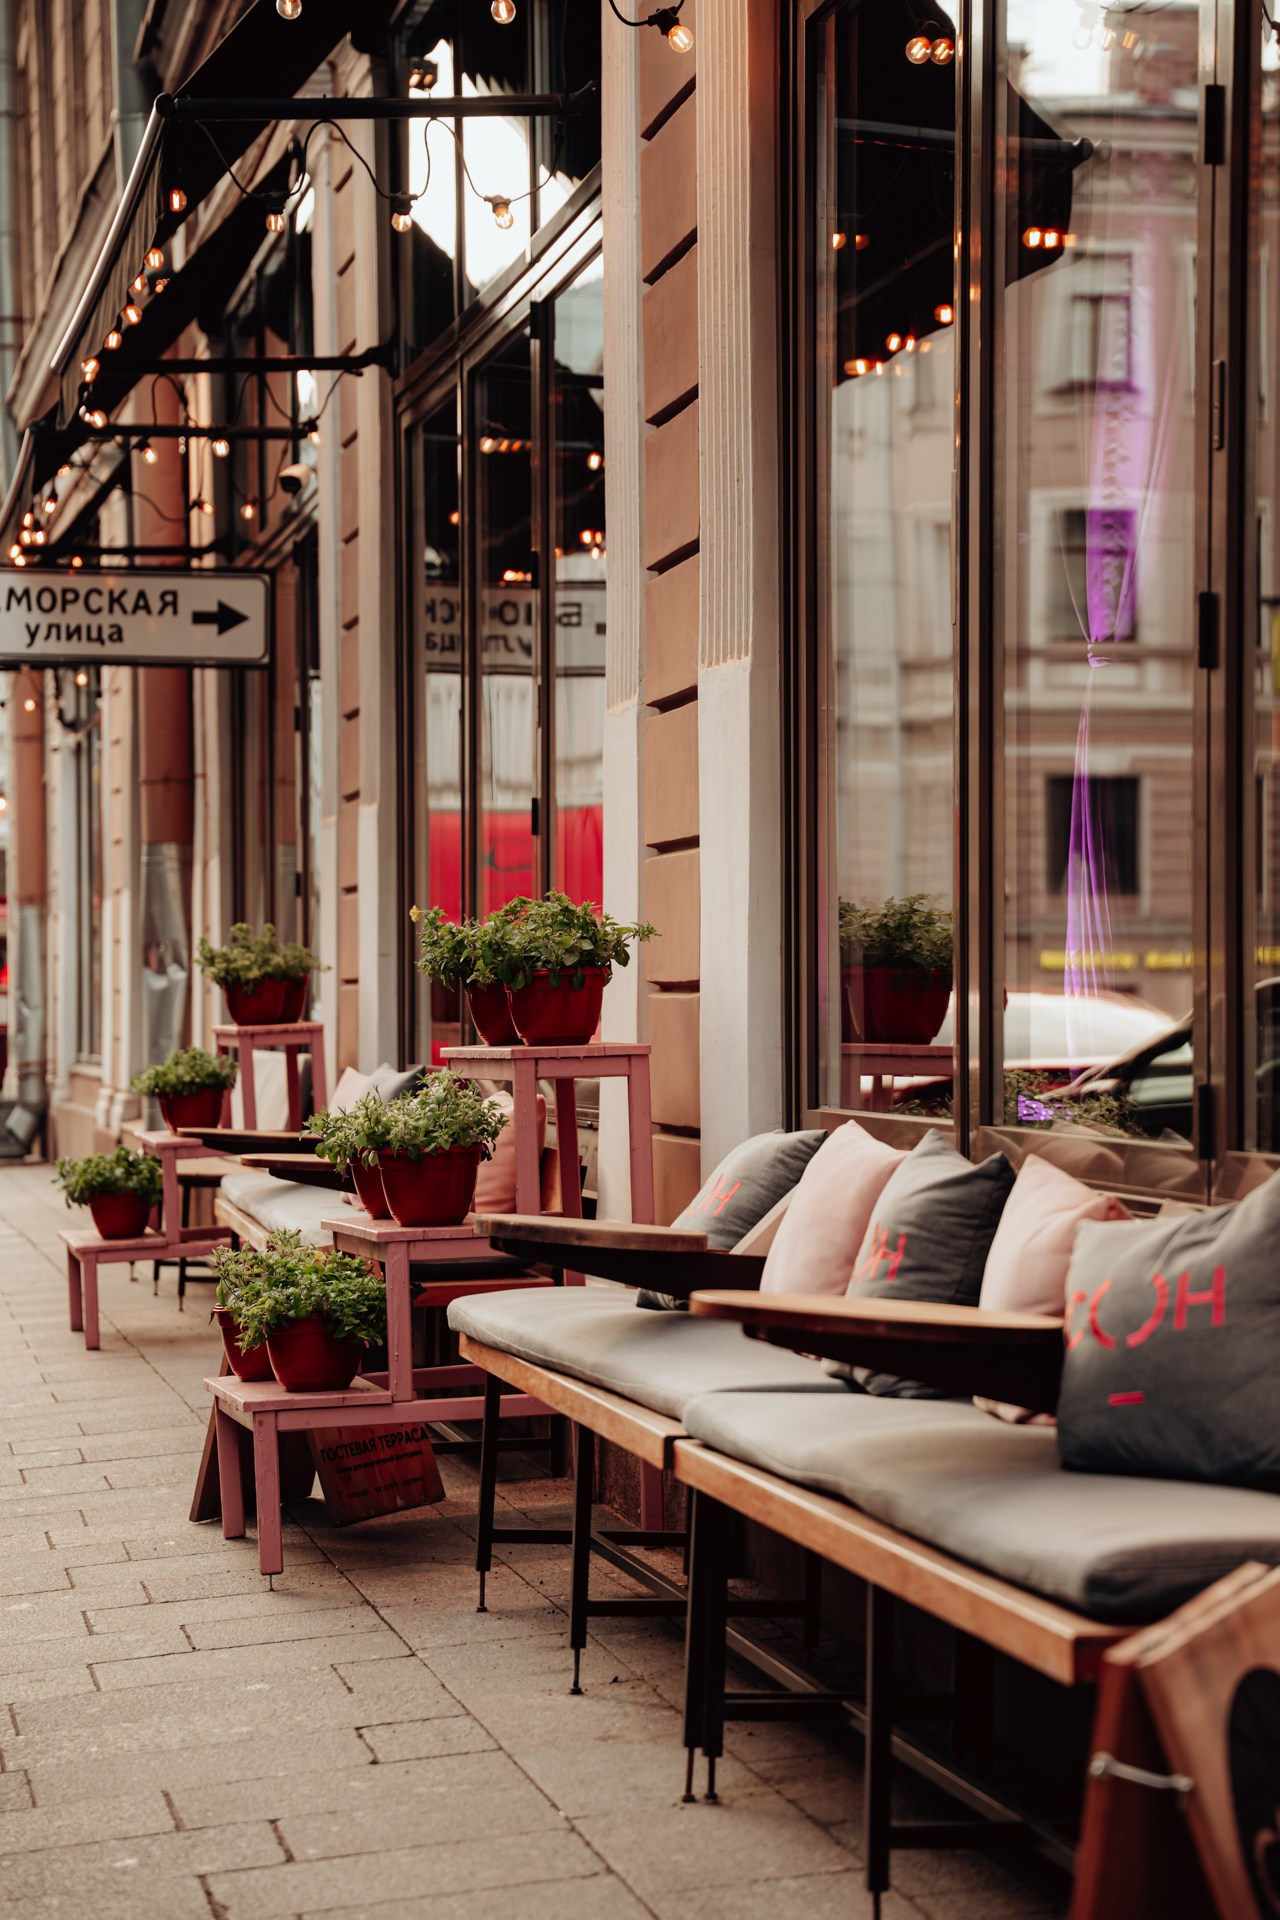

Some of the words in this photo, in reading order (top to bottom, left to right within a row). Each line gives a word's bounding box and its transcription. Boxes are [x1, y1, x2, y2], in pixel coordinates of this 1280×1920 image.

[6, 586, 179, 616] МОРСКАЯ
[25, 623, 124, 648] улица
[320, 1438, 377, 1463] ГОСТЕВАЯ
[377, 1426, 429, 1449] ТЕРРАСА
